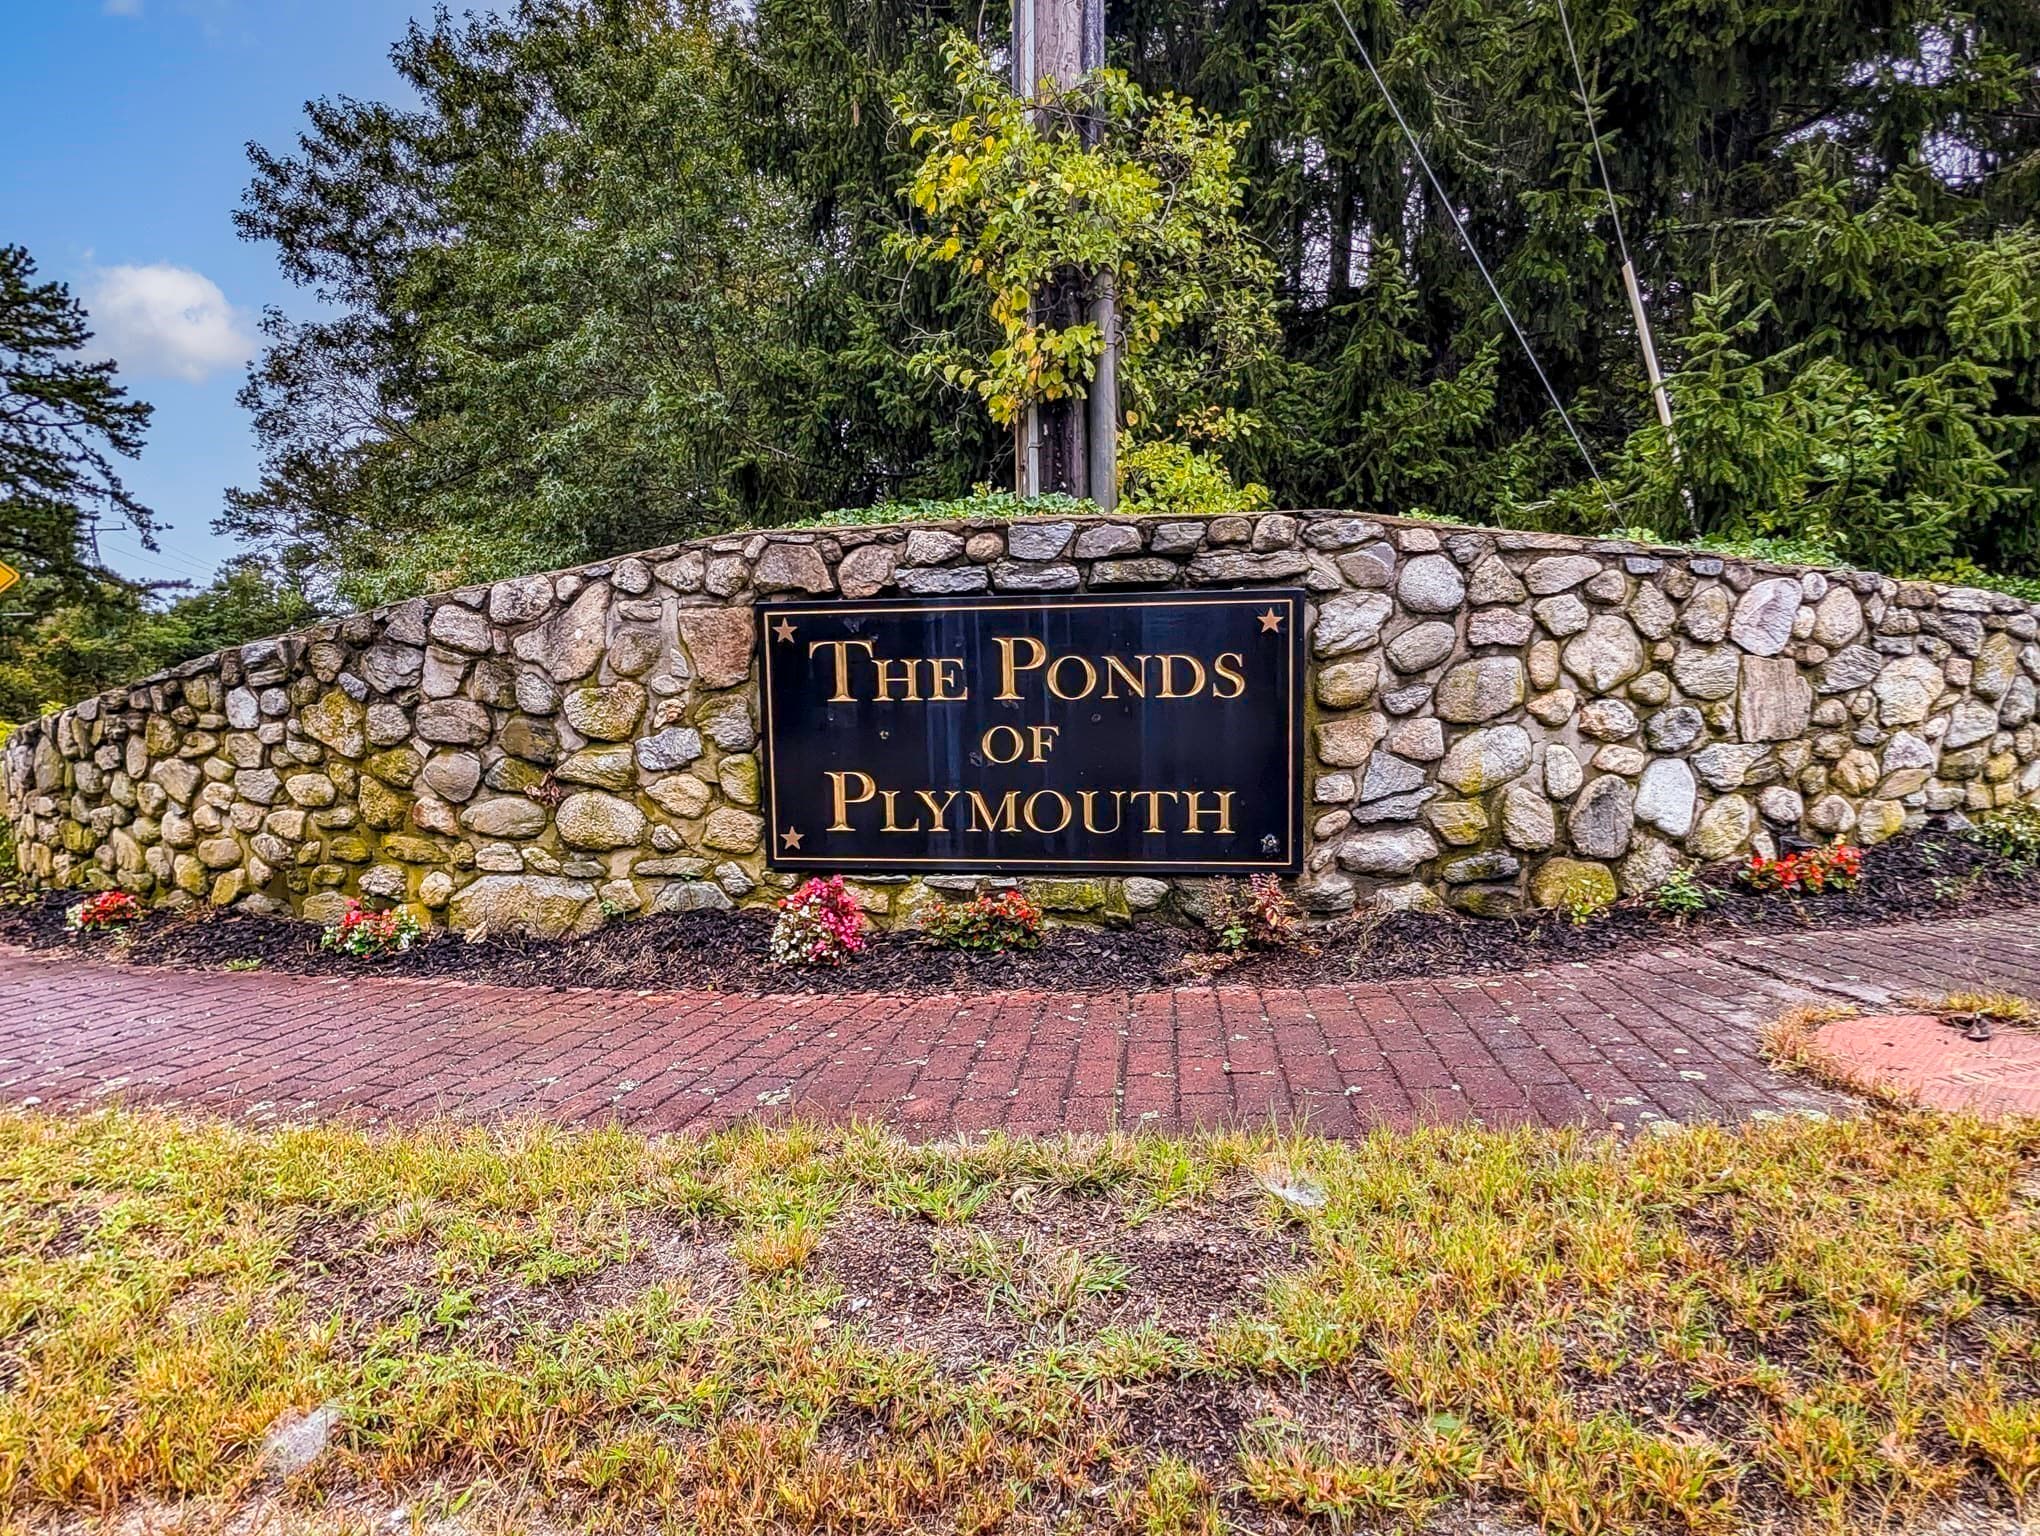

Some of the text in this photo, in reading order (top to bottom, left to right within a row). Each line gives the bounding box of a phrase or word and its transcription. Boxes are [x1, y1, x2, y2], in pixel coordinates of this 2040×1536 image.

[808, 636, 1246, 702] THE PONDS
[981, 725, 1060, 763] OF
[824, 770, 1238, 834] PLYMOUTH
